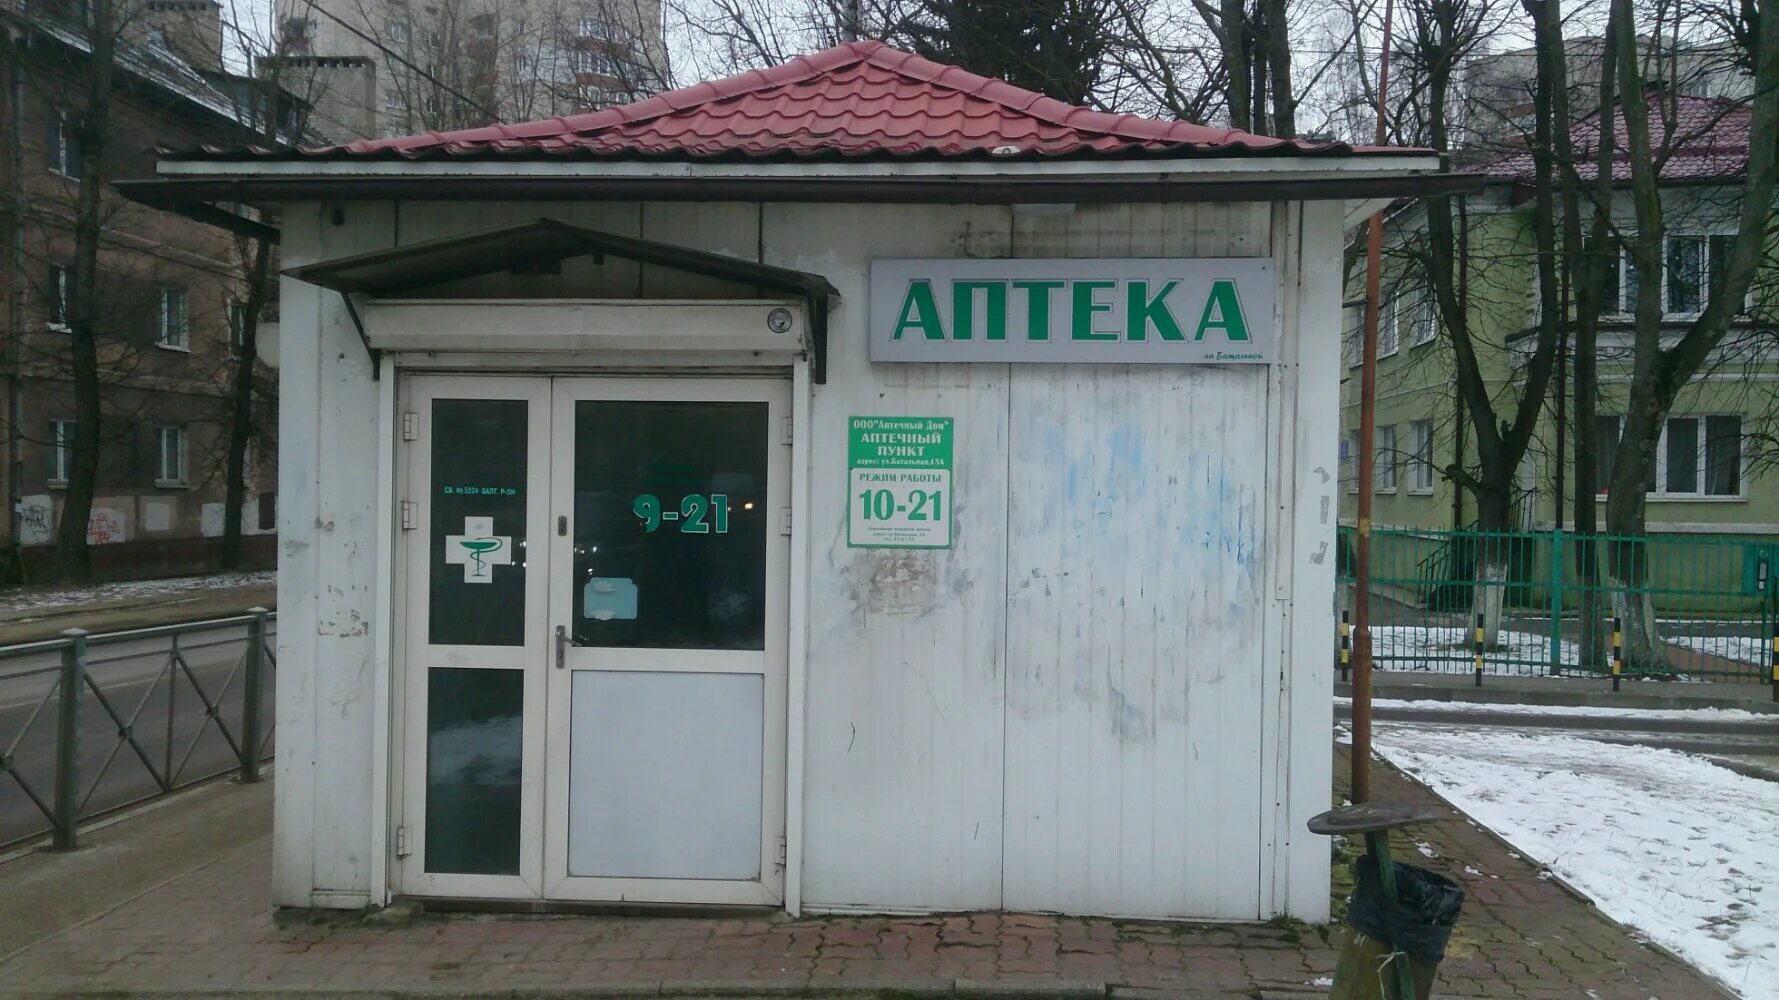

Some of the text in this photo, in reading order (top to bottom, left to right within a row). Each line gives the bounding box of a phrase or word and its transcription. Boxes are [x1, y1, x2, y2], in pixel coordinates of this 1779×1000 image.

[890, 278, 1253, 343] АПТЕКА
[1216, 351, 1263, 361] Батальной
[861, 432, 941, 444] АПТЕЧНЫЙ
[877, 445, 925, 456] ПУНКТ
[859, 473, 941, 483] РЕЖИМ РАБОТЫ
[859, 489, 942, 521] 10-21
[633, 494, 728, 533] 9-21
